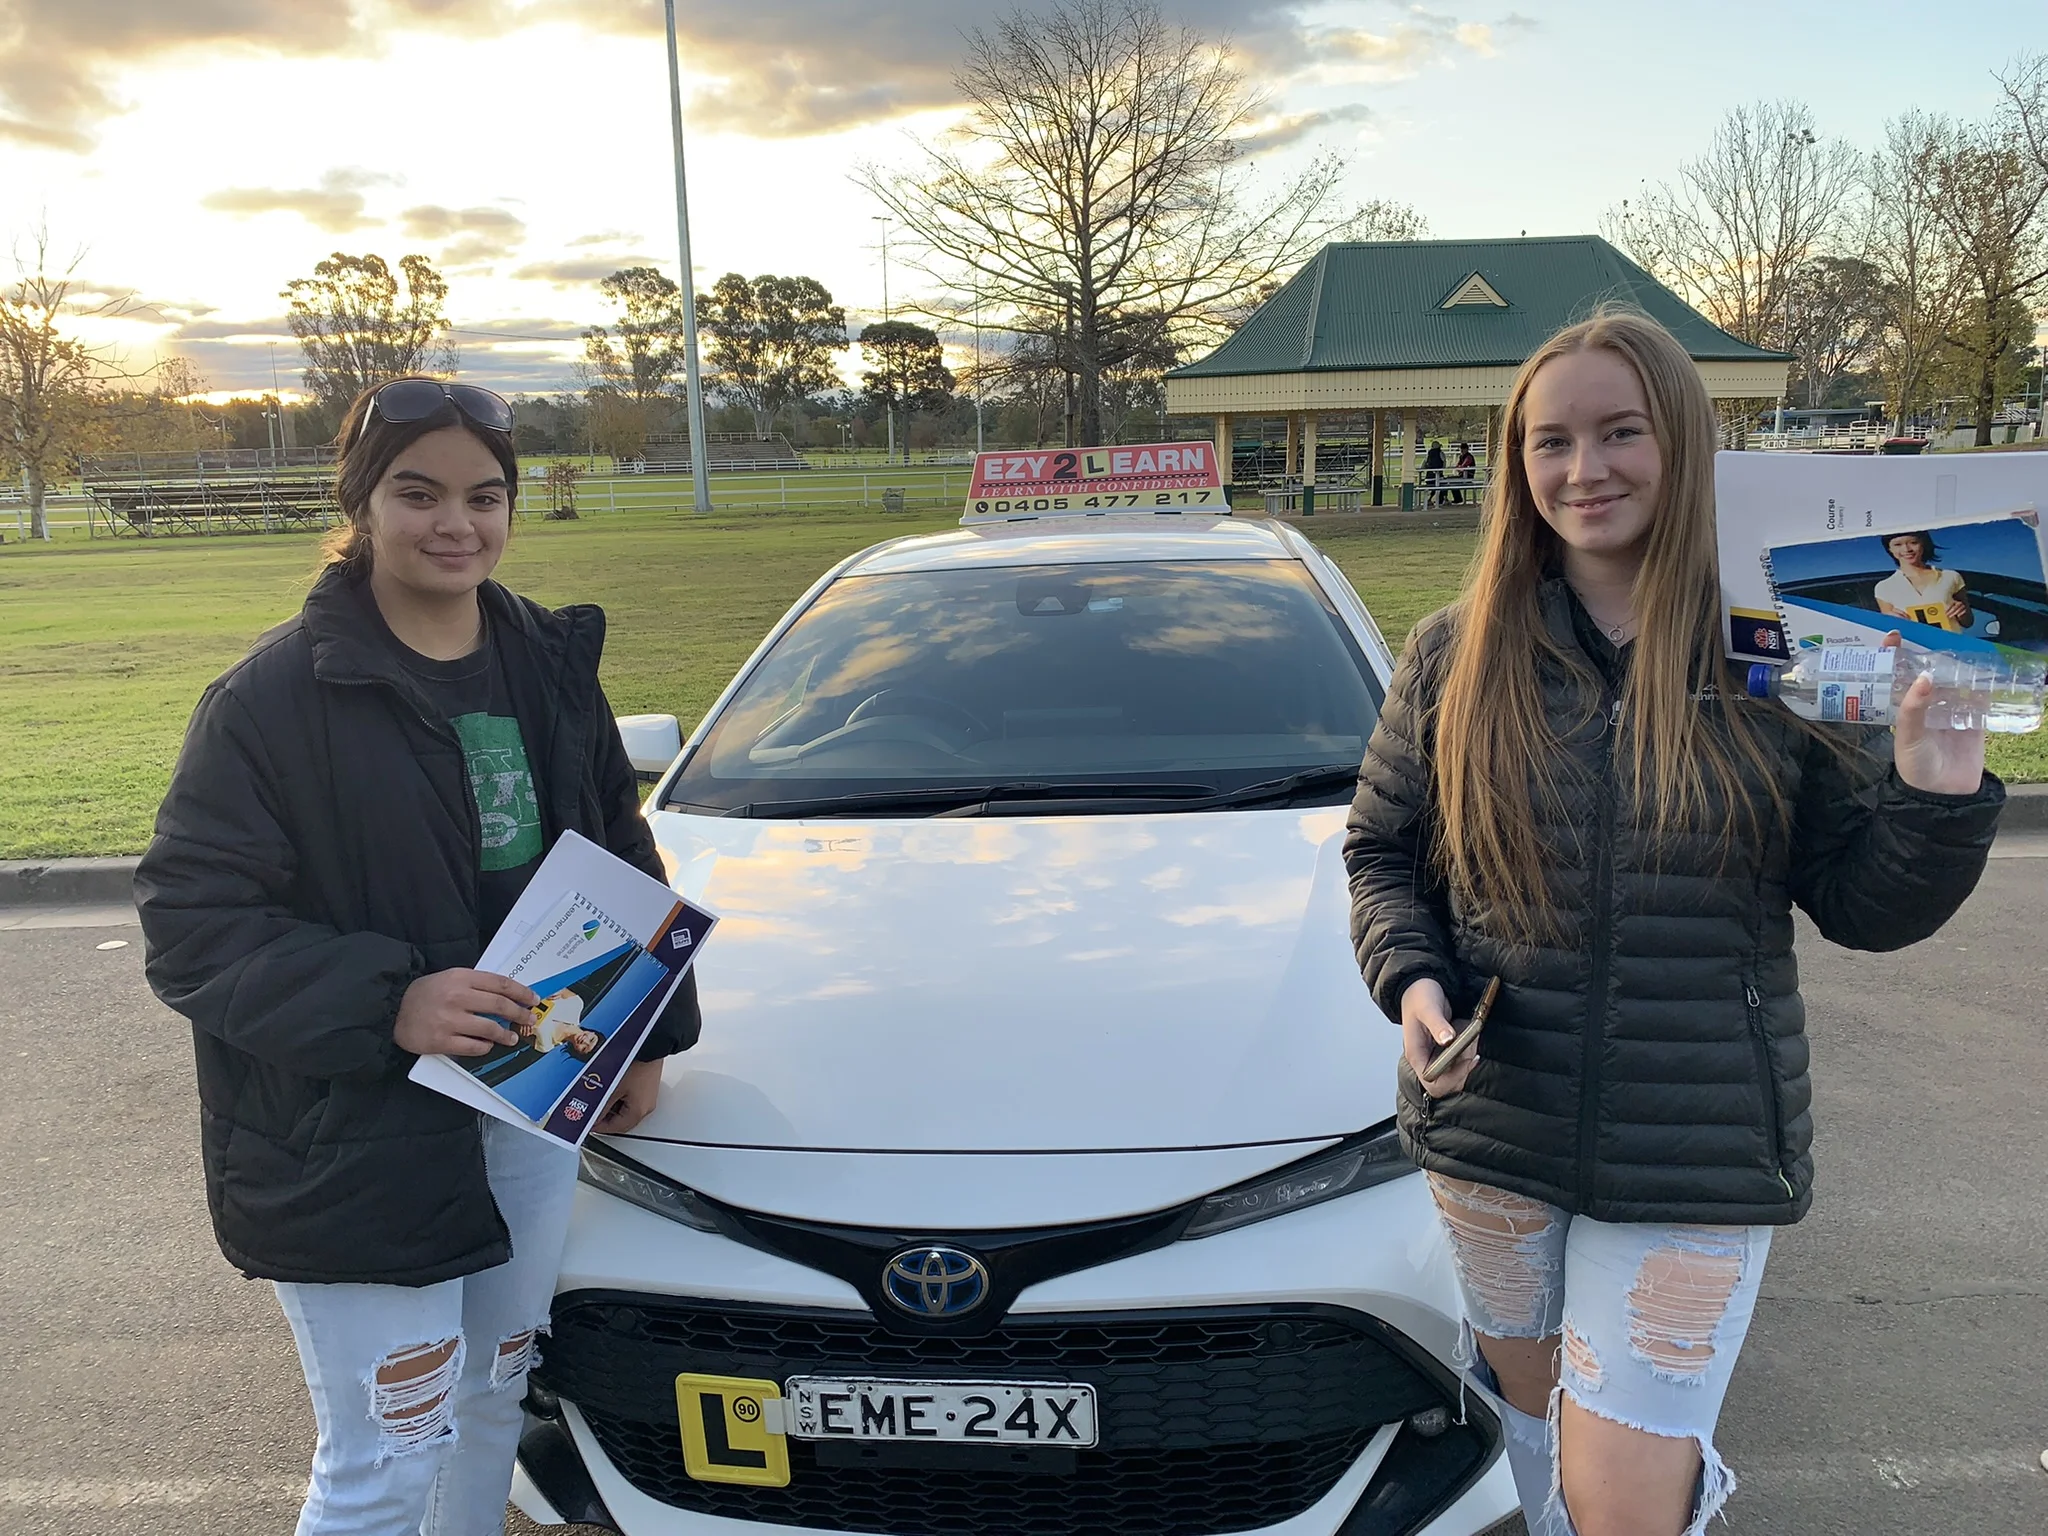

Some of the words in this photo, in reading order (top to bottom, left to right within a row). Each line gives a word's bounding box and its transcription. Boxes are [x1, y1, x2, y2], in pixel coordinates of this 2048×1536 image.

[980, 486, 1036, 498] LEARN
[1043, 483, 1090, 495] WITH
[1095, 477, 1209, 492] CONFIDENCE
[994, 498, 1069, 513] 0405
[1084, 495, 1140, 508] 477
[1155, 491, 1211, 505] 217
[1826, 498, 1836, 530] Course
[1769, 630, 1777, 650] NSW
[554, 903, 580, 930] Learner
[535, 929, 557, 949] Driver
[567, 937, 585, 955] Roads
[520, 950, 537, 964] Log
[508, 963, 525, 980] Boo
[699, 1392, 768, 1469] L
[738, 1403, 756, 1417] 90
